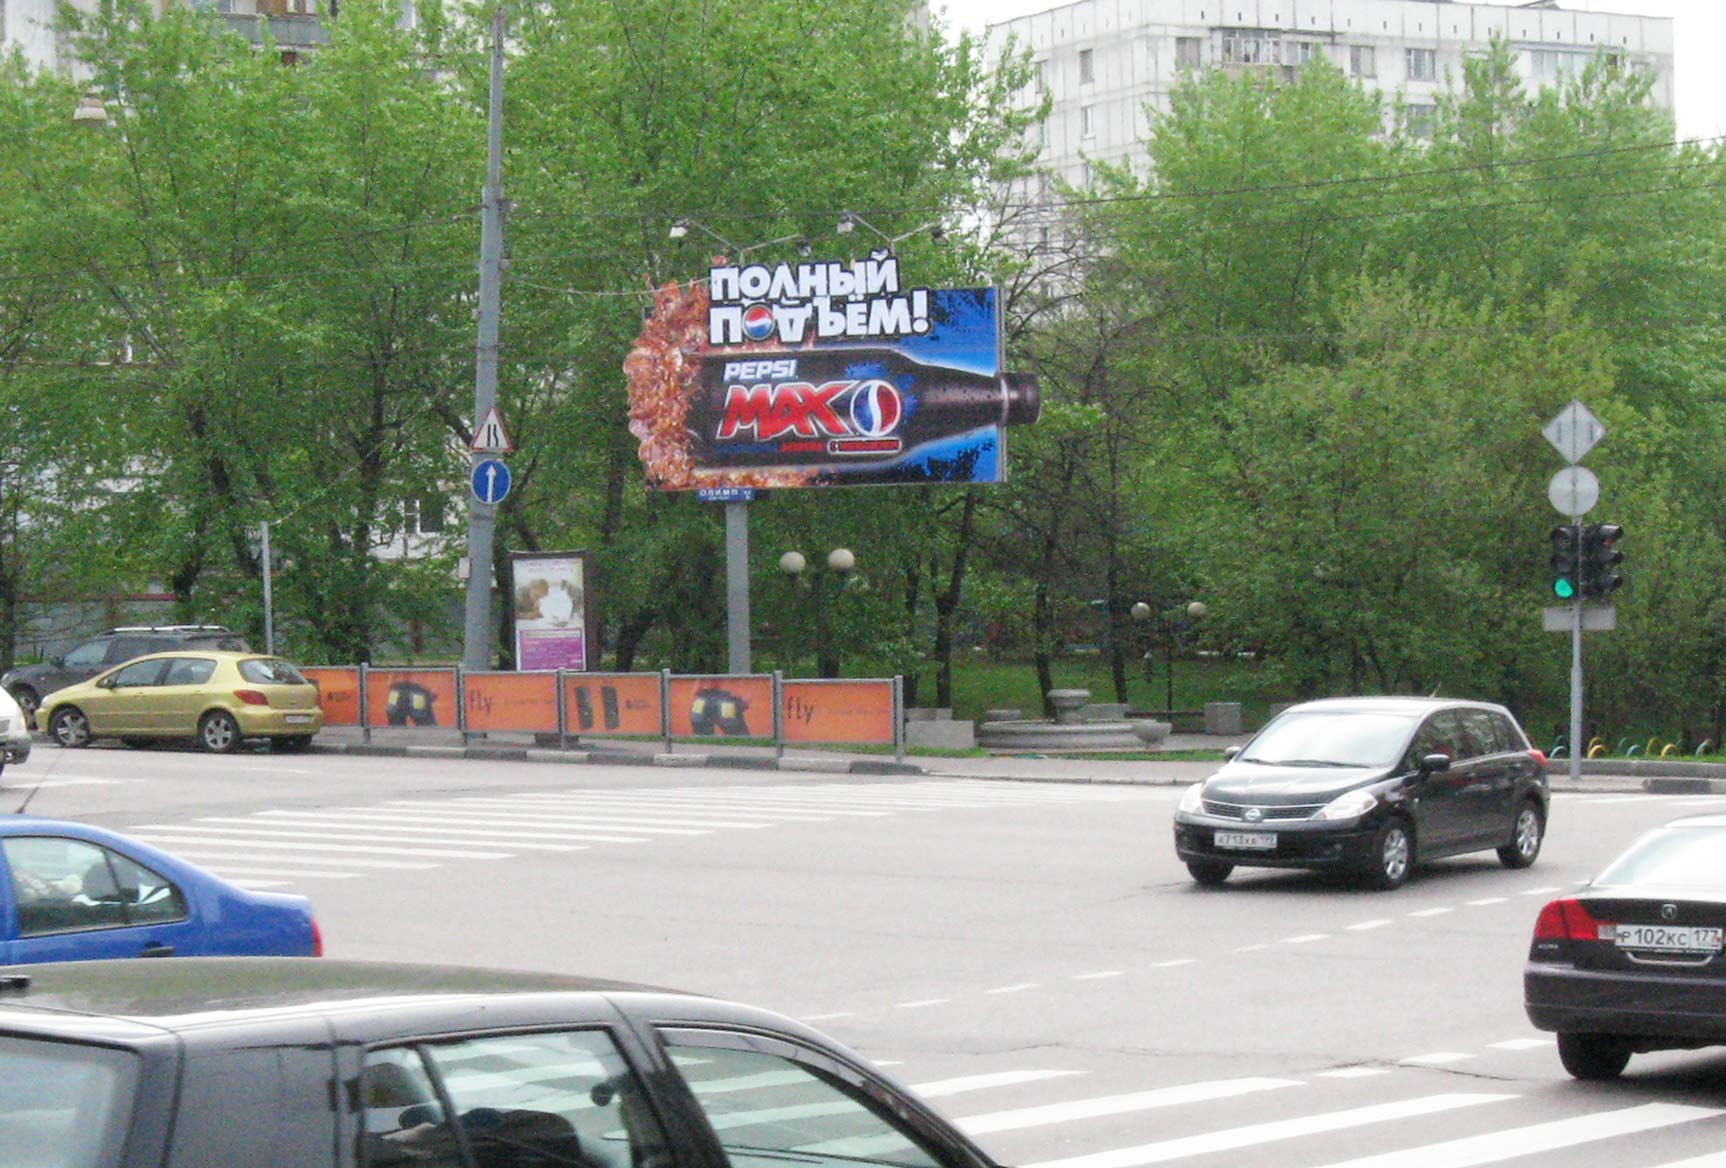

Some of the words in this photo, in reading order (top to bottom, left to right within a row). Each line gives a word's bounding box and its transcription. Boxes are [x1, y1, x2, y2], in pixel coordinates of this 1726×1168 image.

[709, 250, 899, 300] ПОЛНЫЙ
[723, 360, 797, 381] PEPSI
[716, 380, 857, 442] MAX
[787, 696, 814, 725] fly
